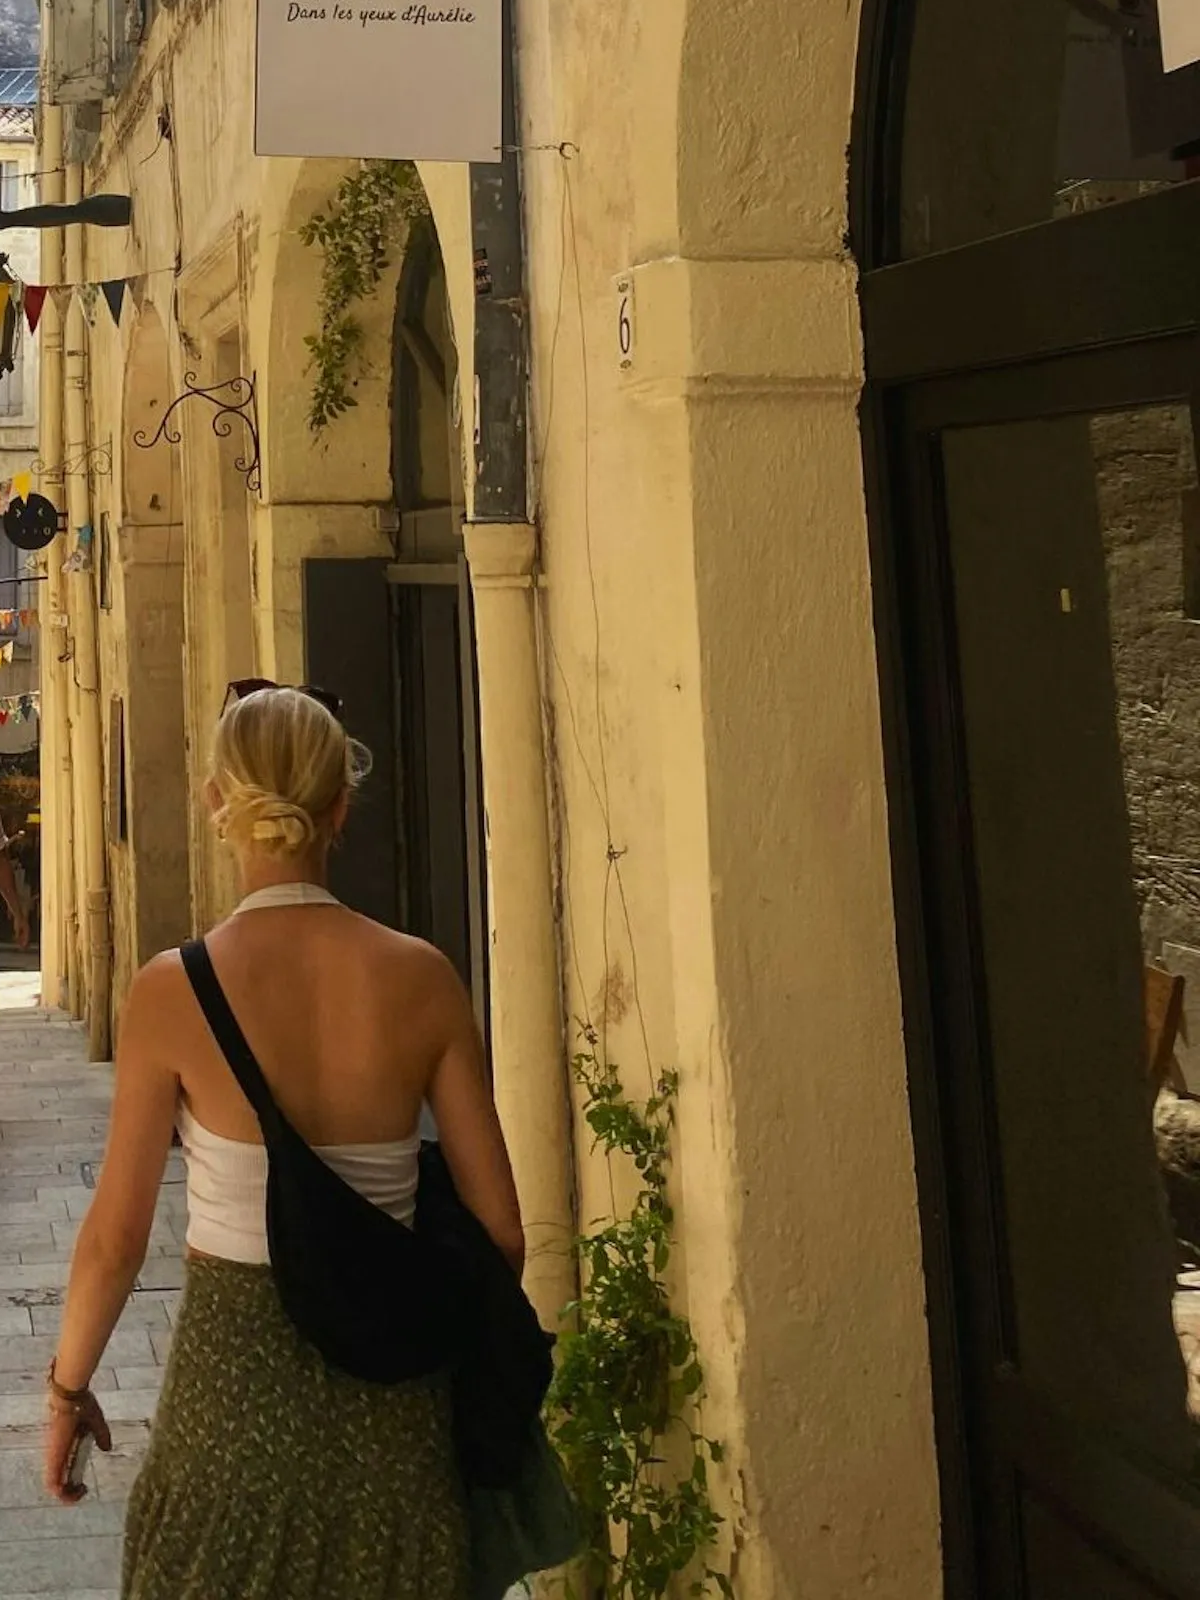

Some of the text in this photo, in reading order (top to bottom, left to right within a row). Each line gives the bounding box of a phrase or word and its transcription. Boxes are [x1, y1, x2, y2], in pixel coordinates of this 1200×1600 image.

[287, 2, 476, 28] Dans les yeux d'Aurélie
[619, 297, 630, 354] 6
